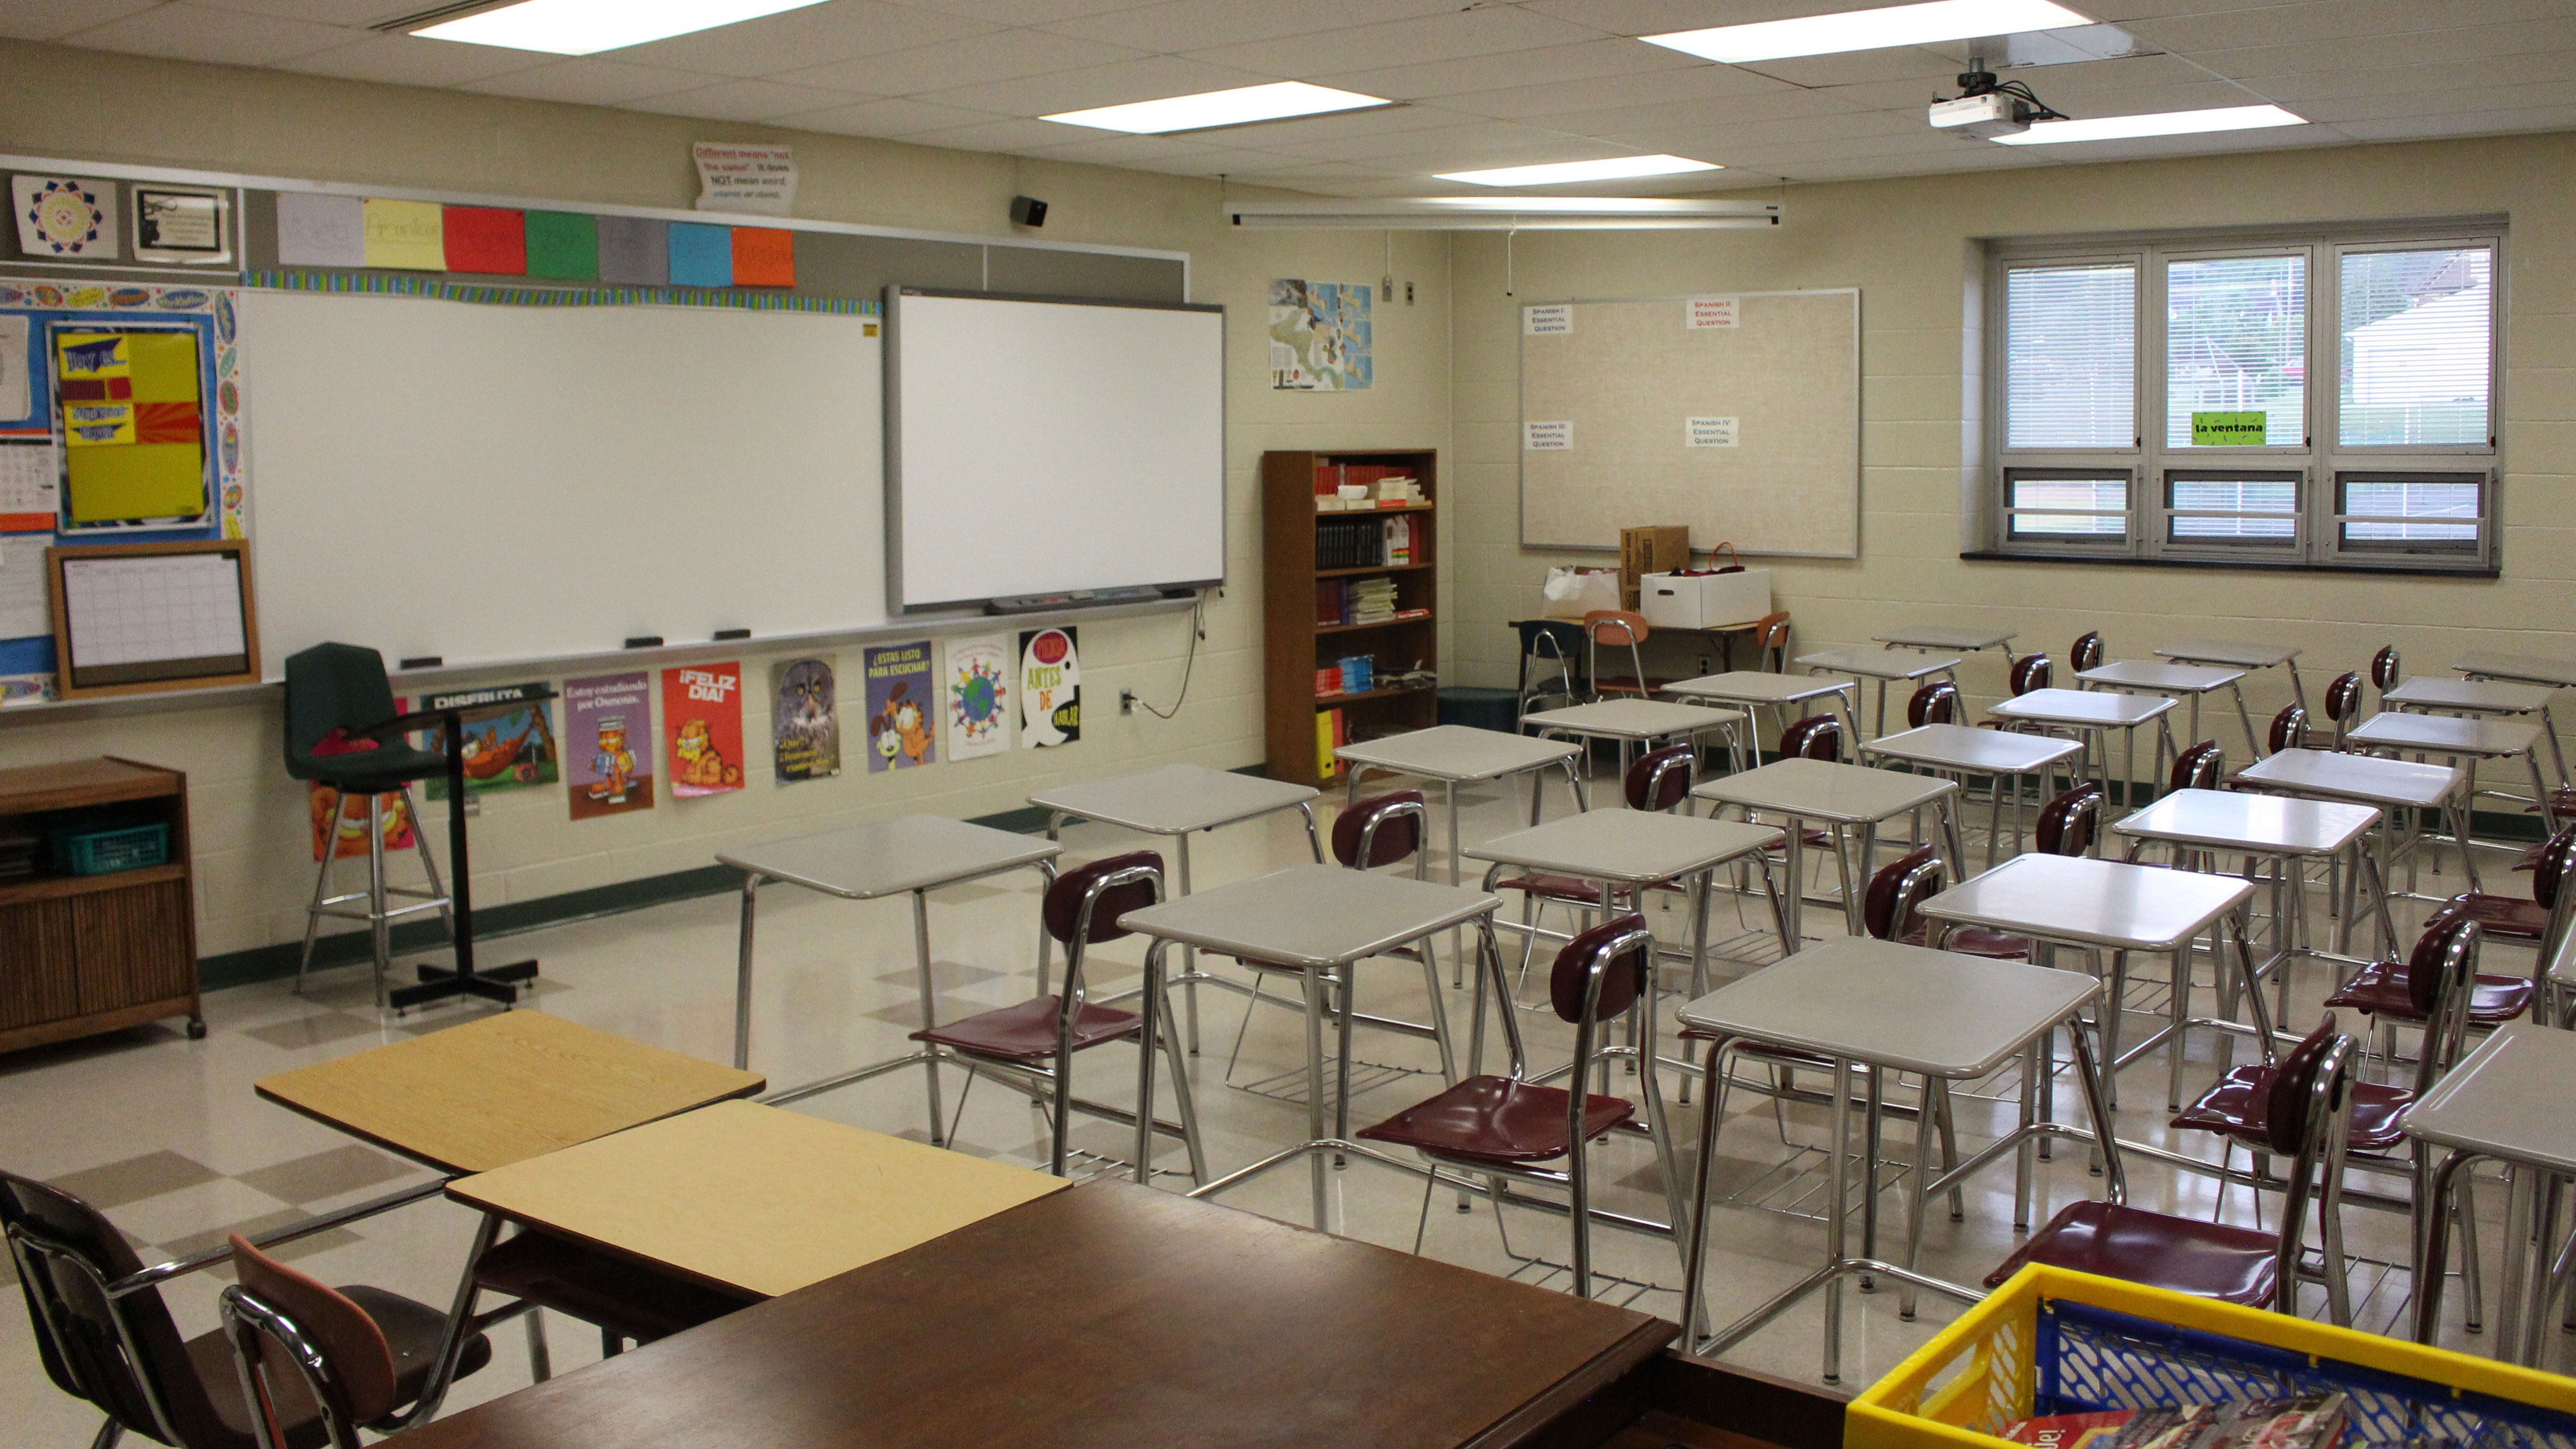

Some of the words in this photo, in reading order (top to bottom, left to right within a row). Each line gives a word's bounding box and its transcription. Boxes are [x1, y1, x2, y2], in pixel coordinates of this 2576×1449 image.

[696, 148, 736, 158] Different
[711, 176, 731, 184] NOT
[2195, 424, 2208, 433] la
[2210, 424, 2263, 432] ventana
[901, 648, 921, 661] LISTO
[869, 666, 888, 678] PARA
[890, 659, 931, 677] ESCUCHAR?
[1027, 666, 1061, 691] ANTES
[566, 687, 594, 698] Estoy
[594, 680, 647, 695] estudiando
[434, 688, 524, 710] DISFRUTA
[578, 700, 593, 712] por
[1039, 689, 1052, 712] DE
